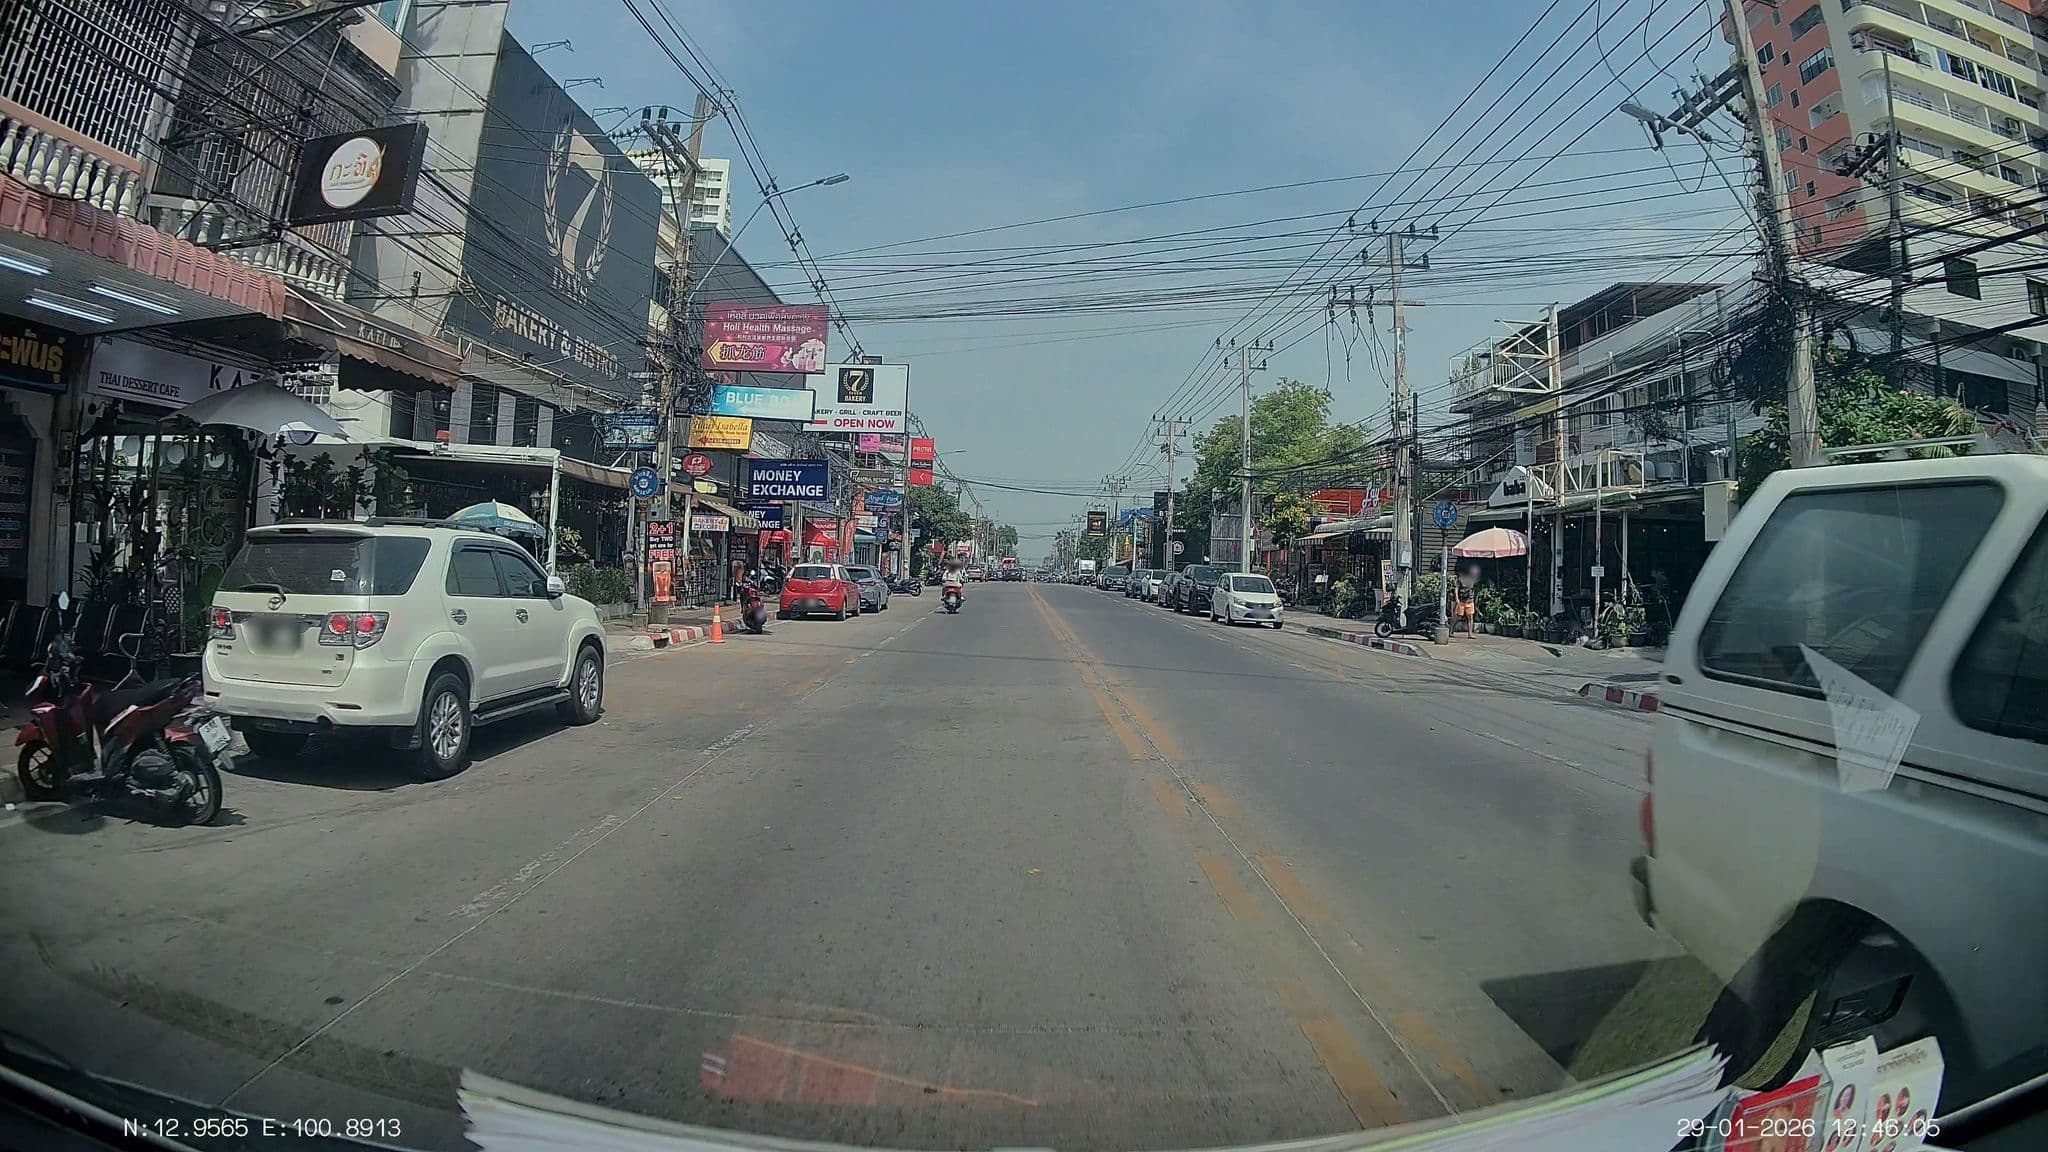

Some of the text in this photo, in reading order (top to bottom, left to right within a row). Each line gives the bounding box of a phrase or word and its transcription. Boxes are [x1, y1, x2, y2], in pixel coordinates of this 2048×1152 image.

[723, 322, 812, 334] Holi Health Massage
[496, 294, 618, 380] BAKERY & BISTRO
[100, 371, 120, 387] THAI
[122, 376, 159, 394] DESSERT
[726, 391, 764, 405] BLUE
[833, 418, 895, 429] OPEN NOW
[753, 469, 802, 482] MONEY
[752, 484, 824, 497] EXCHANGE
[649, 522, 674, 534] 2+1
[649, 549, 674, 559] FREE
